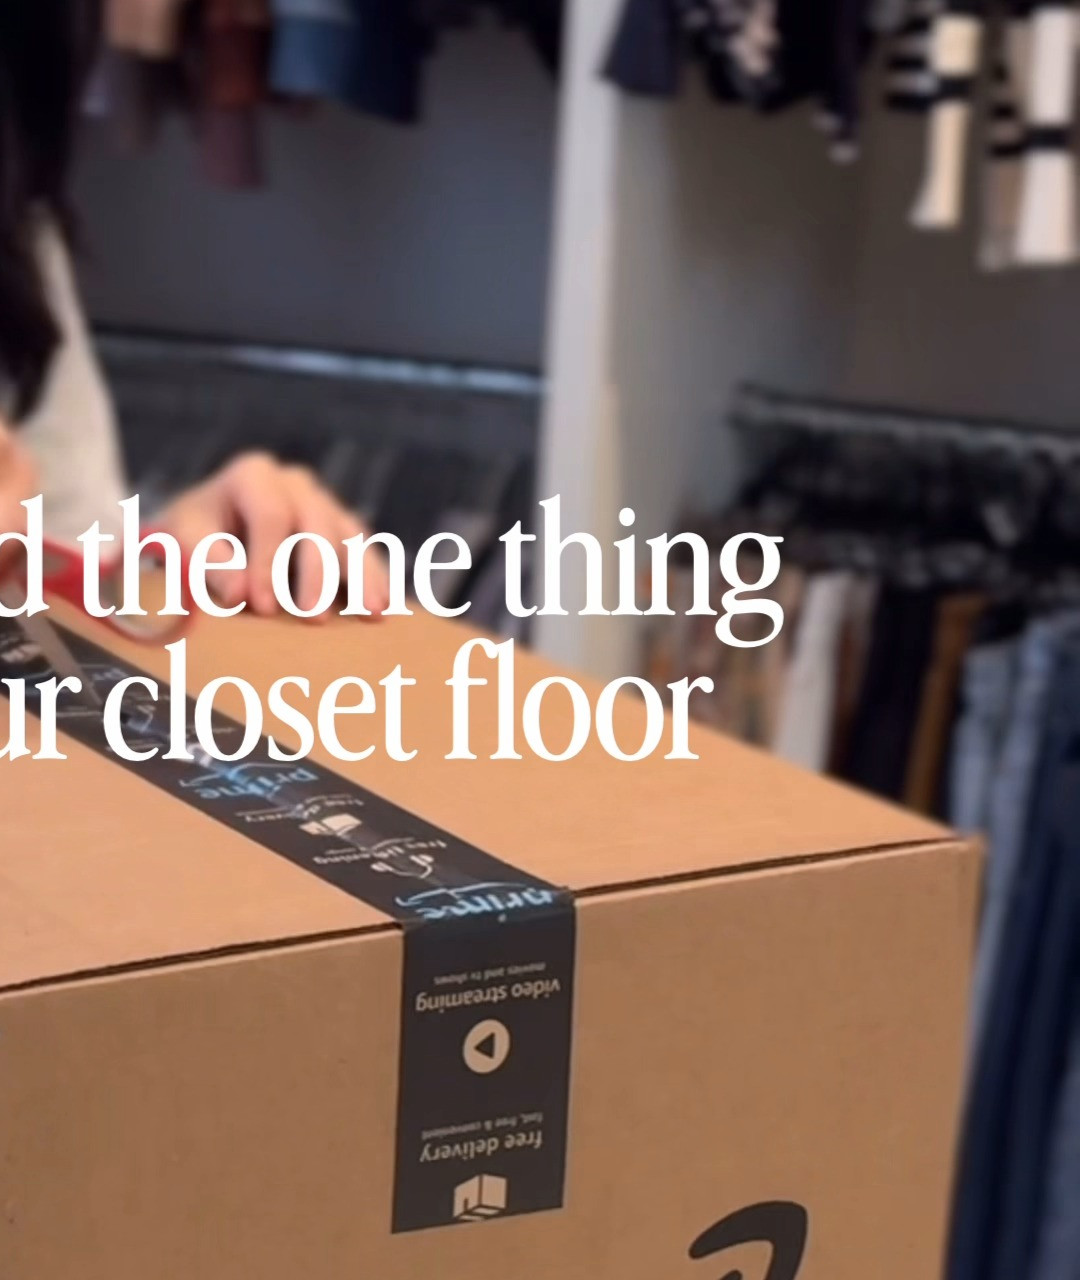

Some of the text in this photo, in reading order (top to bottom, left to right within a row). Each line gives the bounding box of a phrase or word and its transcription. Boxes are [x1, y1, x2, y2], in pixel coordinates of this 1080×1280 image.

[414, 888, 554, 923] prime
[483, 967, 505, 981] and
[415, 978, 561, 1013] video streaming
[419, 1130, 544, 1163] free delivery
